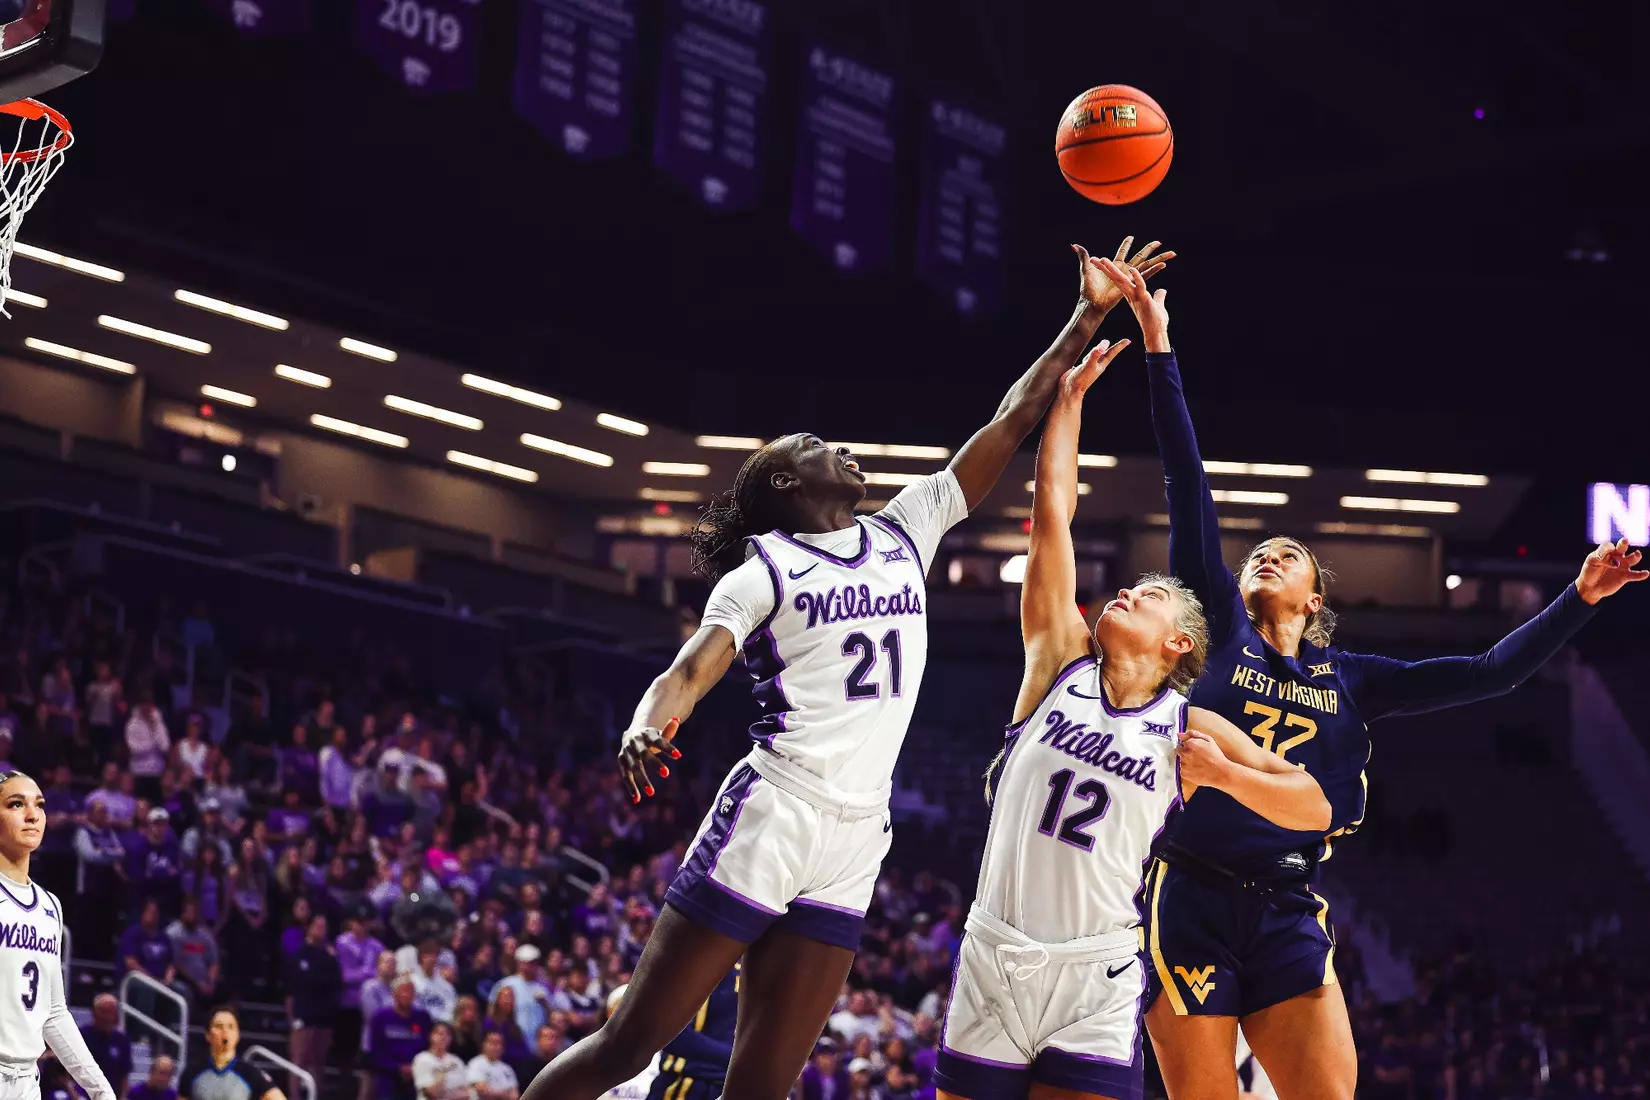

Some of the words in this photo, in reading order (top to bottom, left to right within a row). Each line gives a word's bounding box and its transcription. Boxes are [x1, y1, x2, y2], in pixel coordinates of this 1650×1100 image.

[379, 0, 462, 50] 2019
[794, 582, 924, 630] Wildcats
[840, 628, 902, 701] 21
[1230, 664, 1276, 697] WEST
[1278, 679, 1339, 715] VIRGINIA
[1308, 661, 1335, 678] XII
[1038, 710, 1157, 792] Wildcats
[1243, 700, 1319, 771] 32
[1038, 768, 1112, 853] 12
[21, 960, 40, 1012] 3
